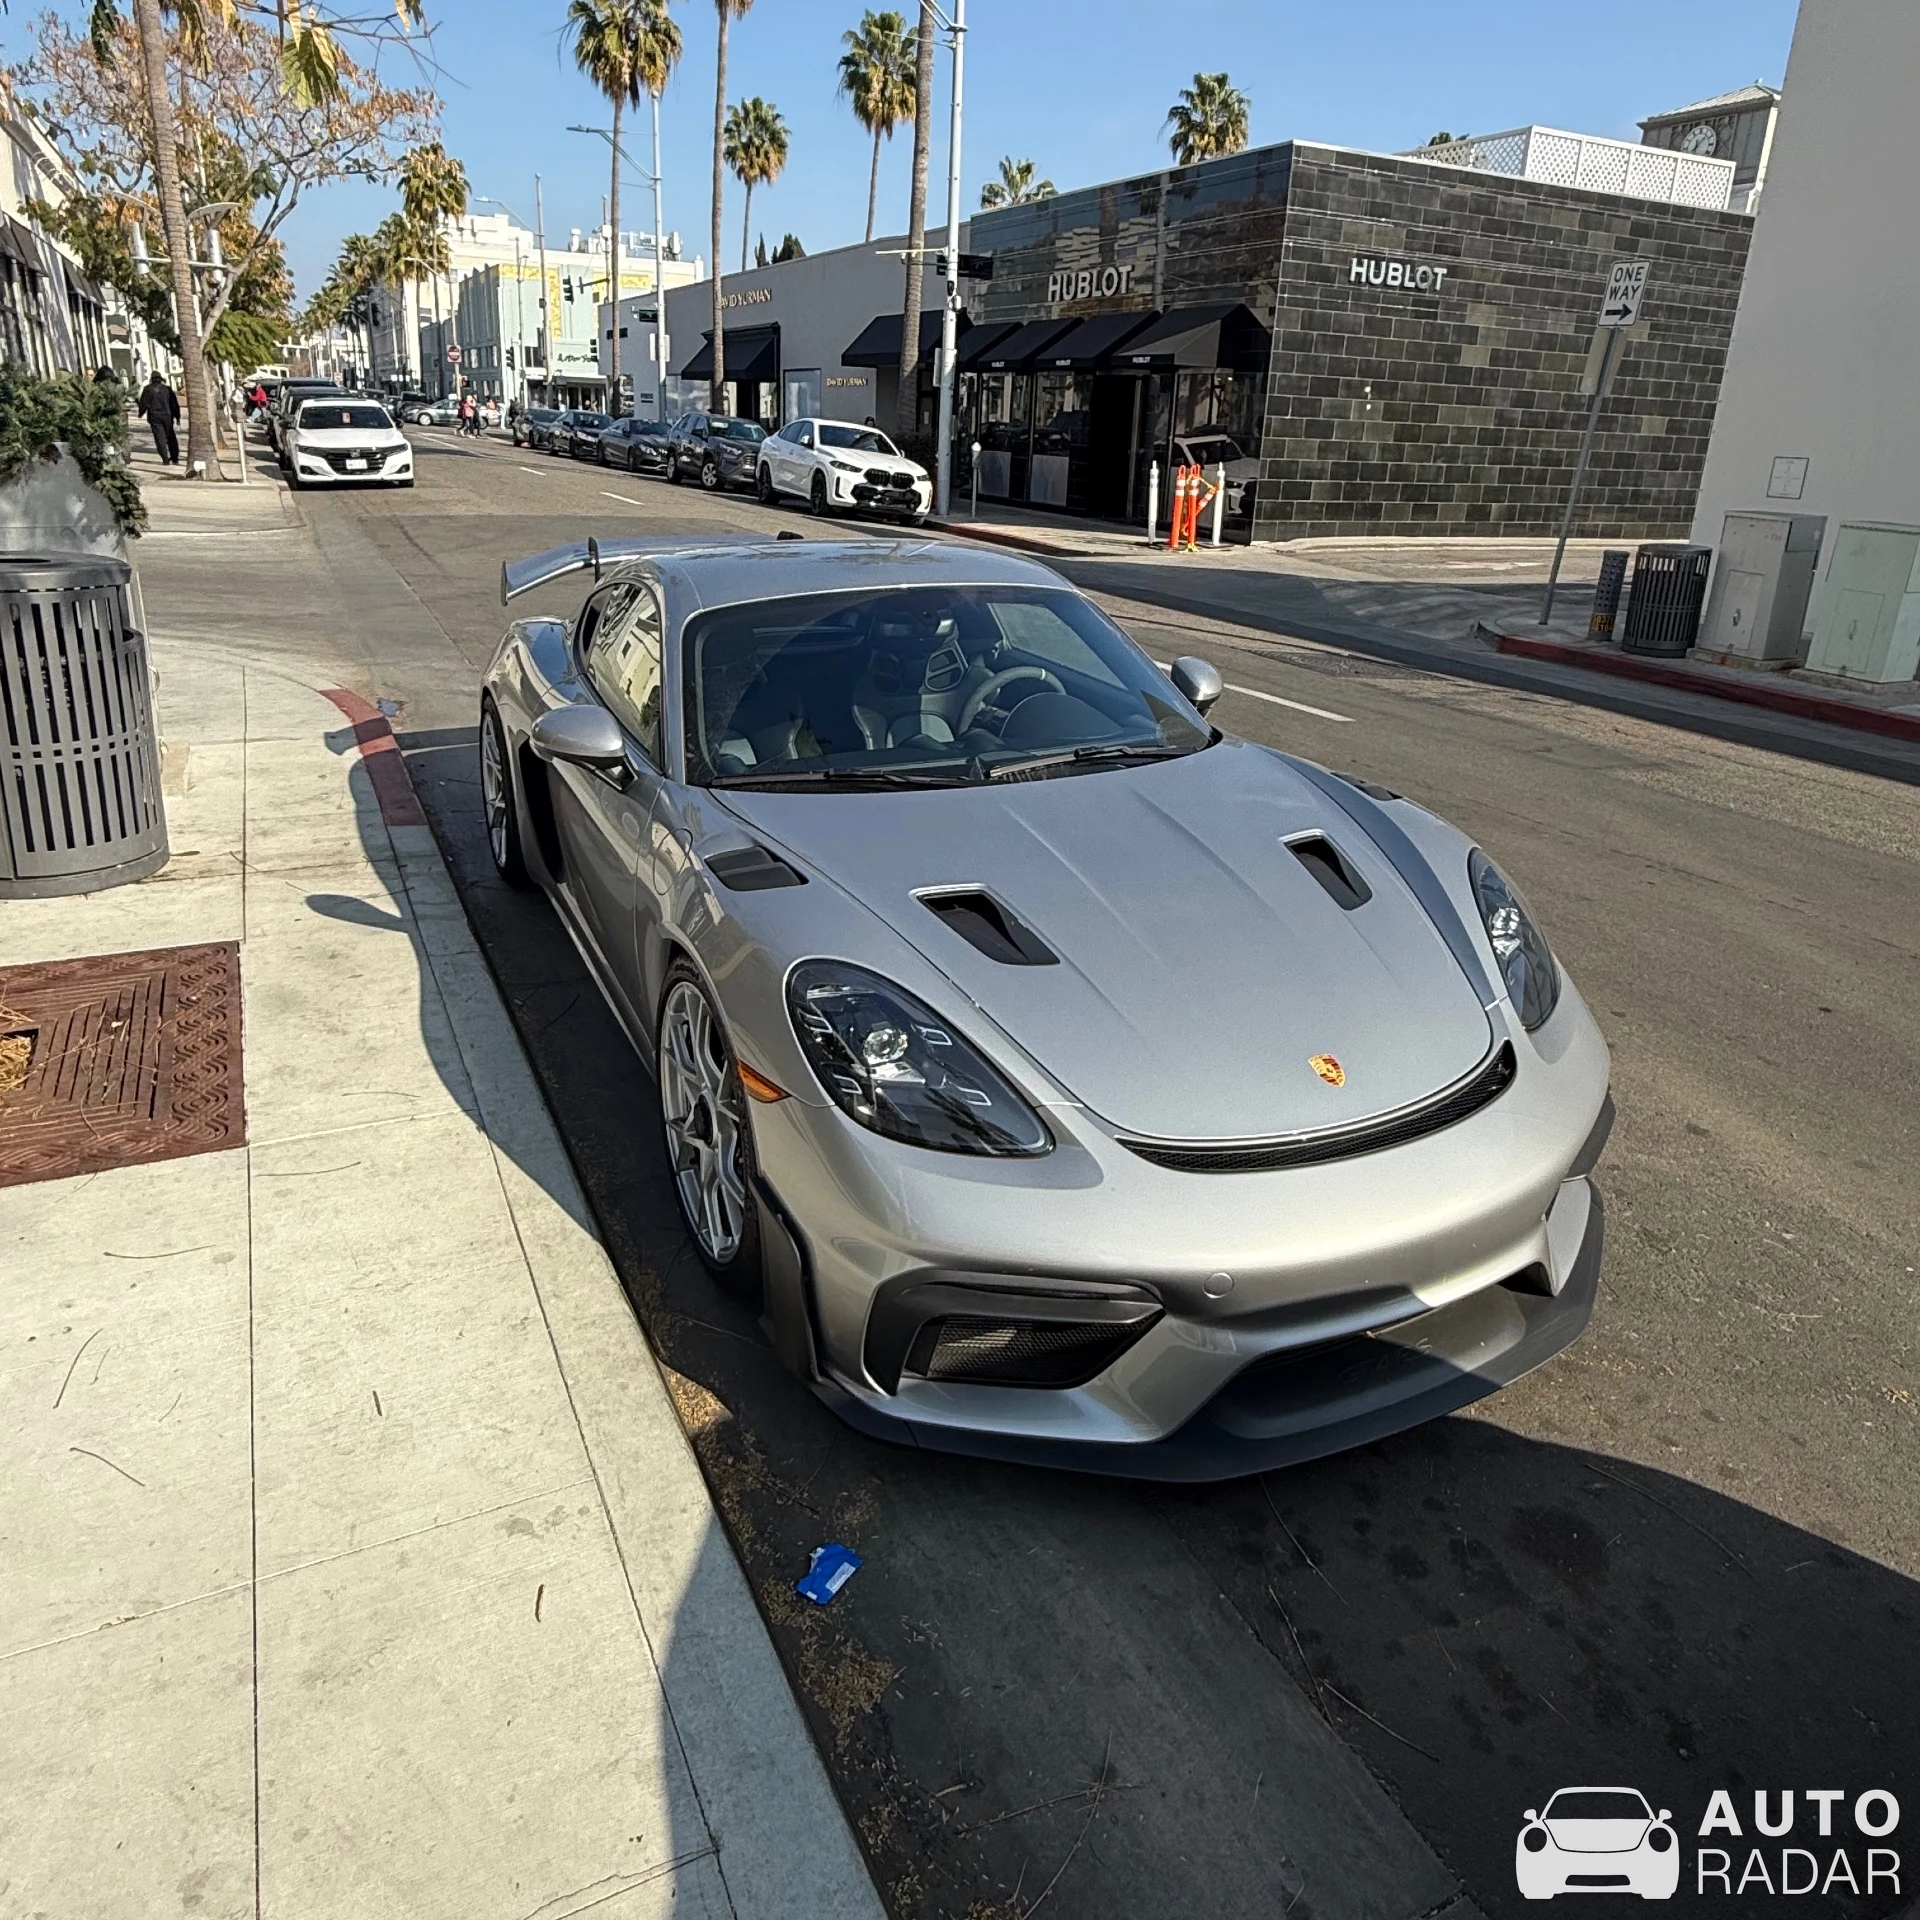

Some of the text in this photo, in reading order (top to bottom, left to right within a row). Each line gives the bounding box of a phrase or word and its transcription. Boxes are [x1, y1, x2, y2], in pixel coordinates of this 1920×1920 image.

[1047, 264, 1133, 302] HUBLOT
[1349, 257, 1448, 291] HUBLOT
[1614, 266, 1645, 283] ONE
[720, 288, 771, 309] AVID YURMAN
[1609, 285, 1641, 301] WAY
[1337, 1337, 1433, 1384] GT4 RS
